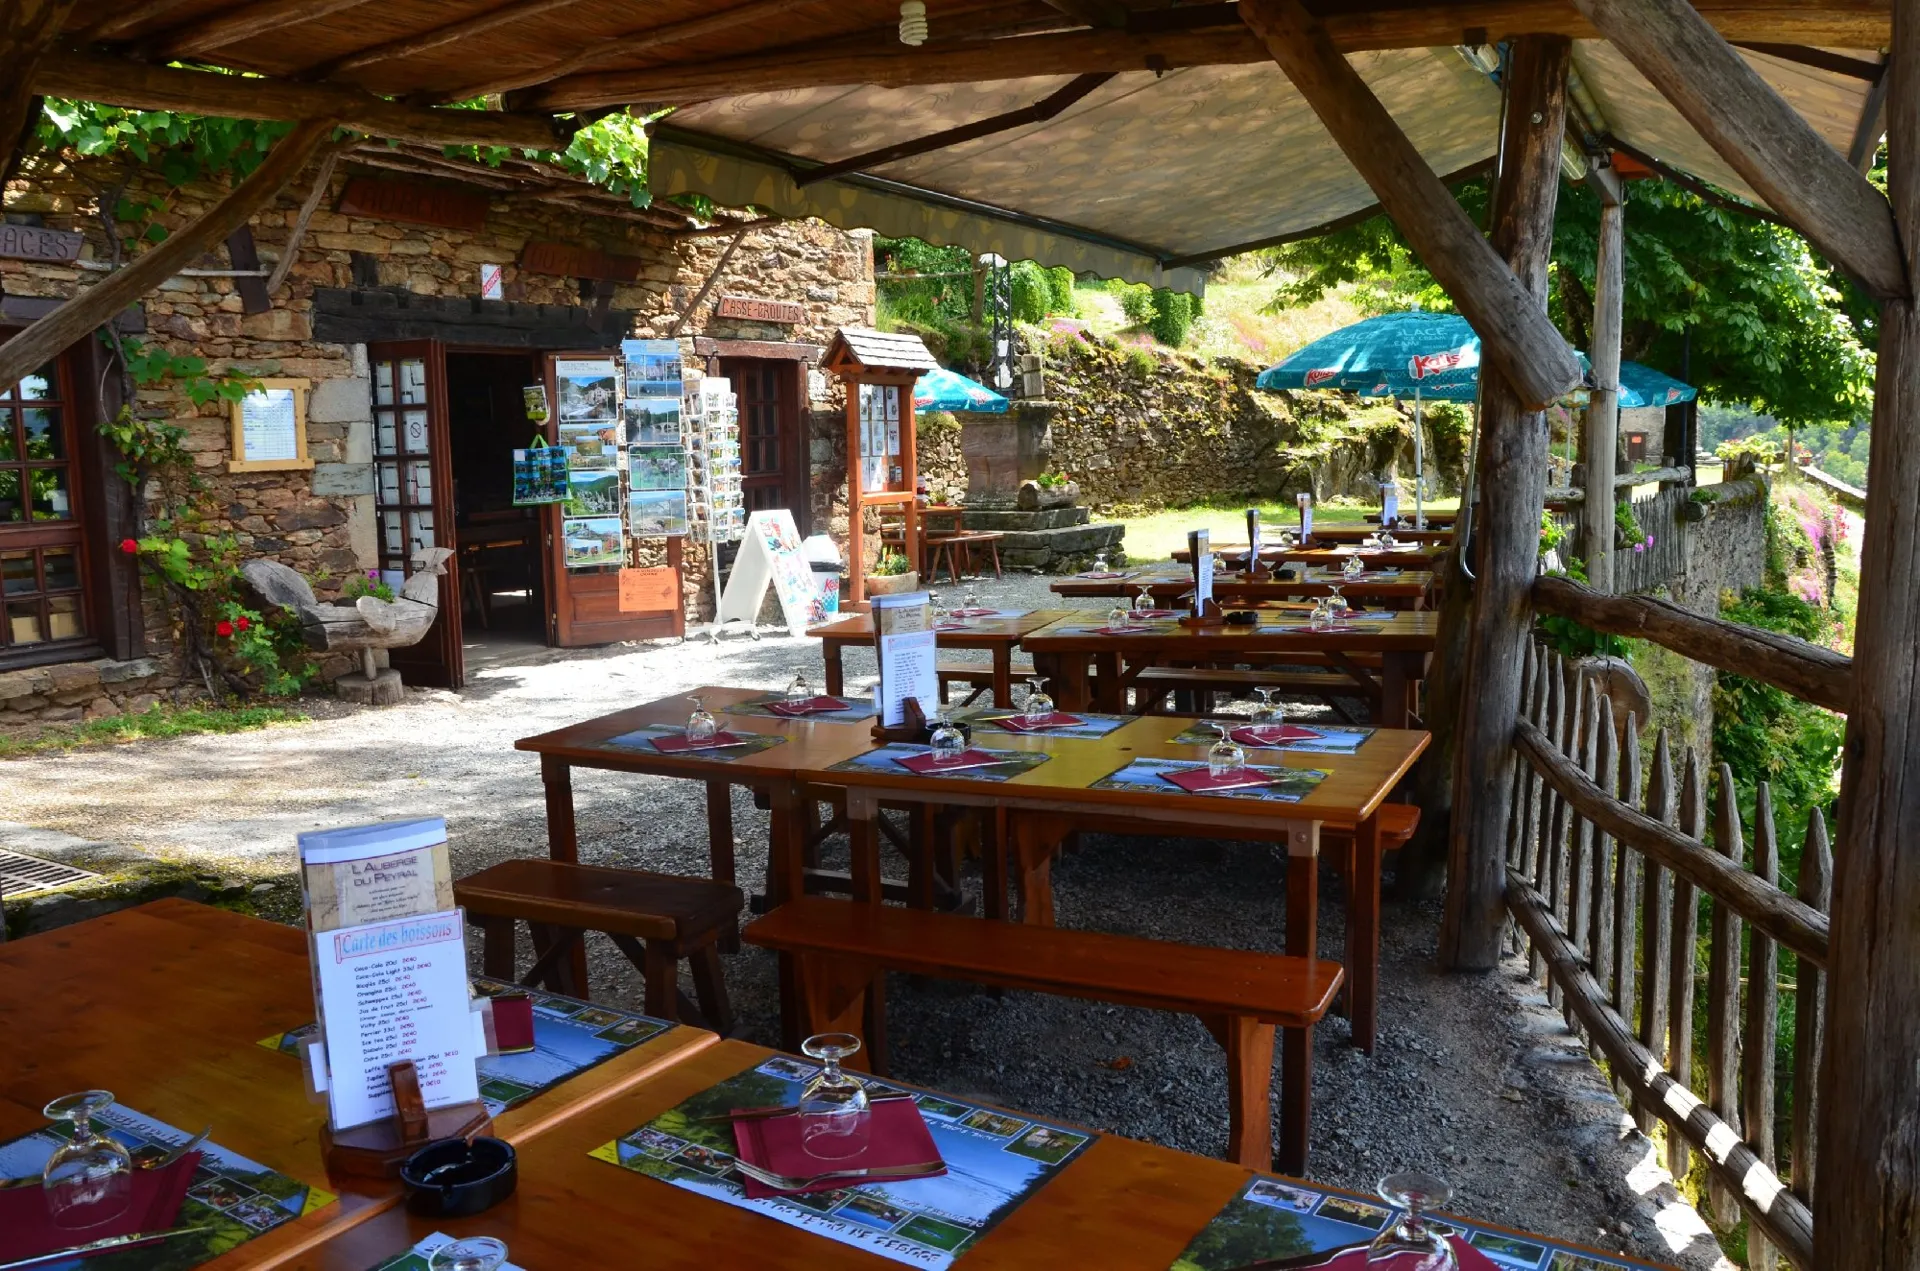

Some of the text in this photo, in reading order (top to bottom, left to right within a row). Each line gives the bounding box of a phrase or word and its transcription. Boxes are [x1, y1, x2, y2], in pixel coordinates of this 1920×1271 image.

[343, 922, 452, 953] Carte des boissons
